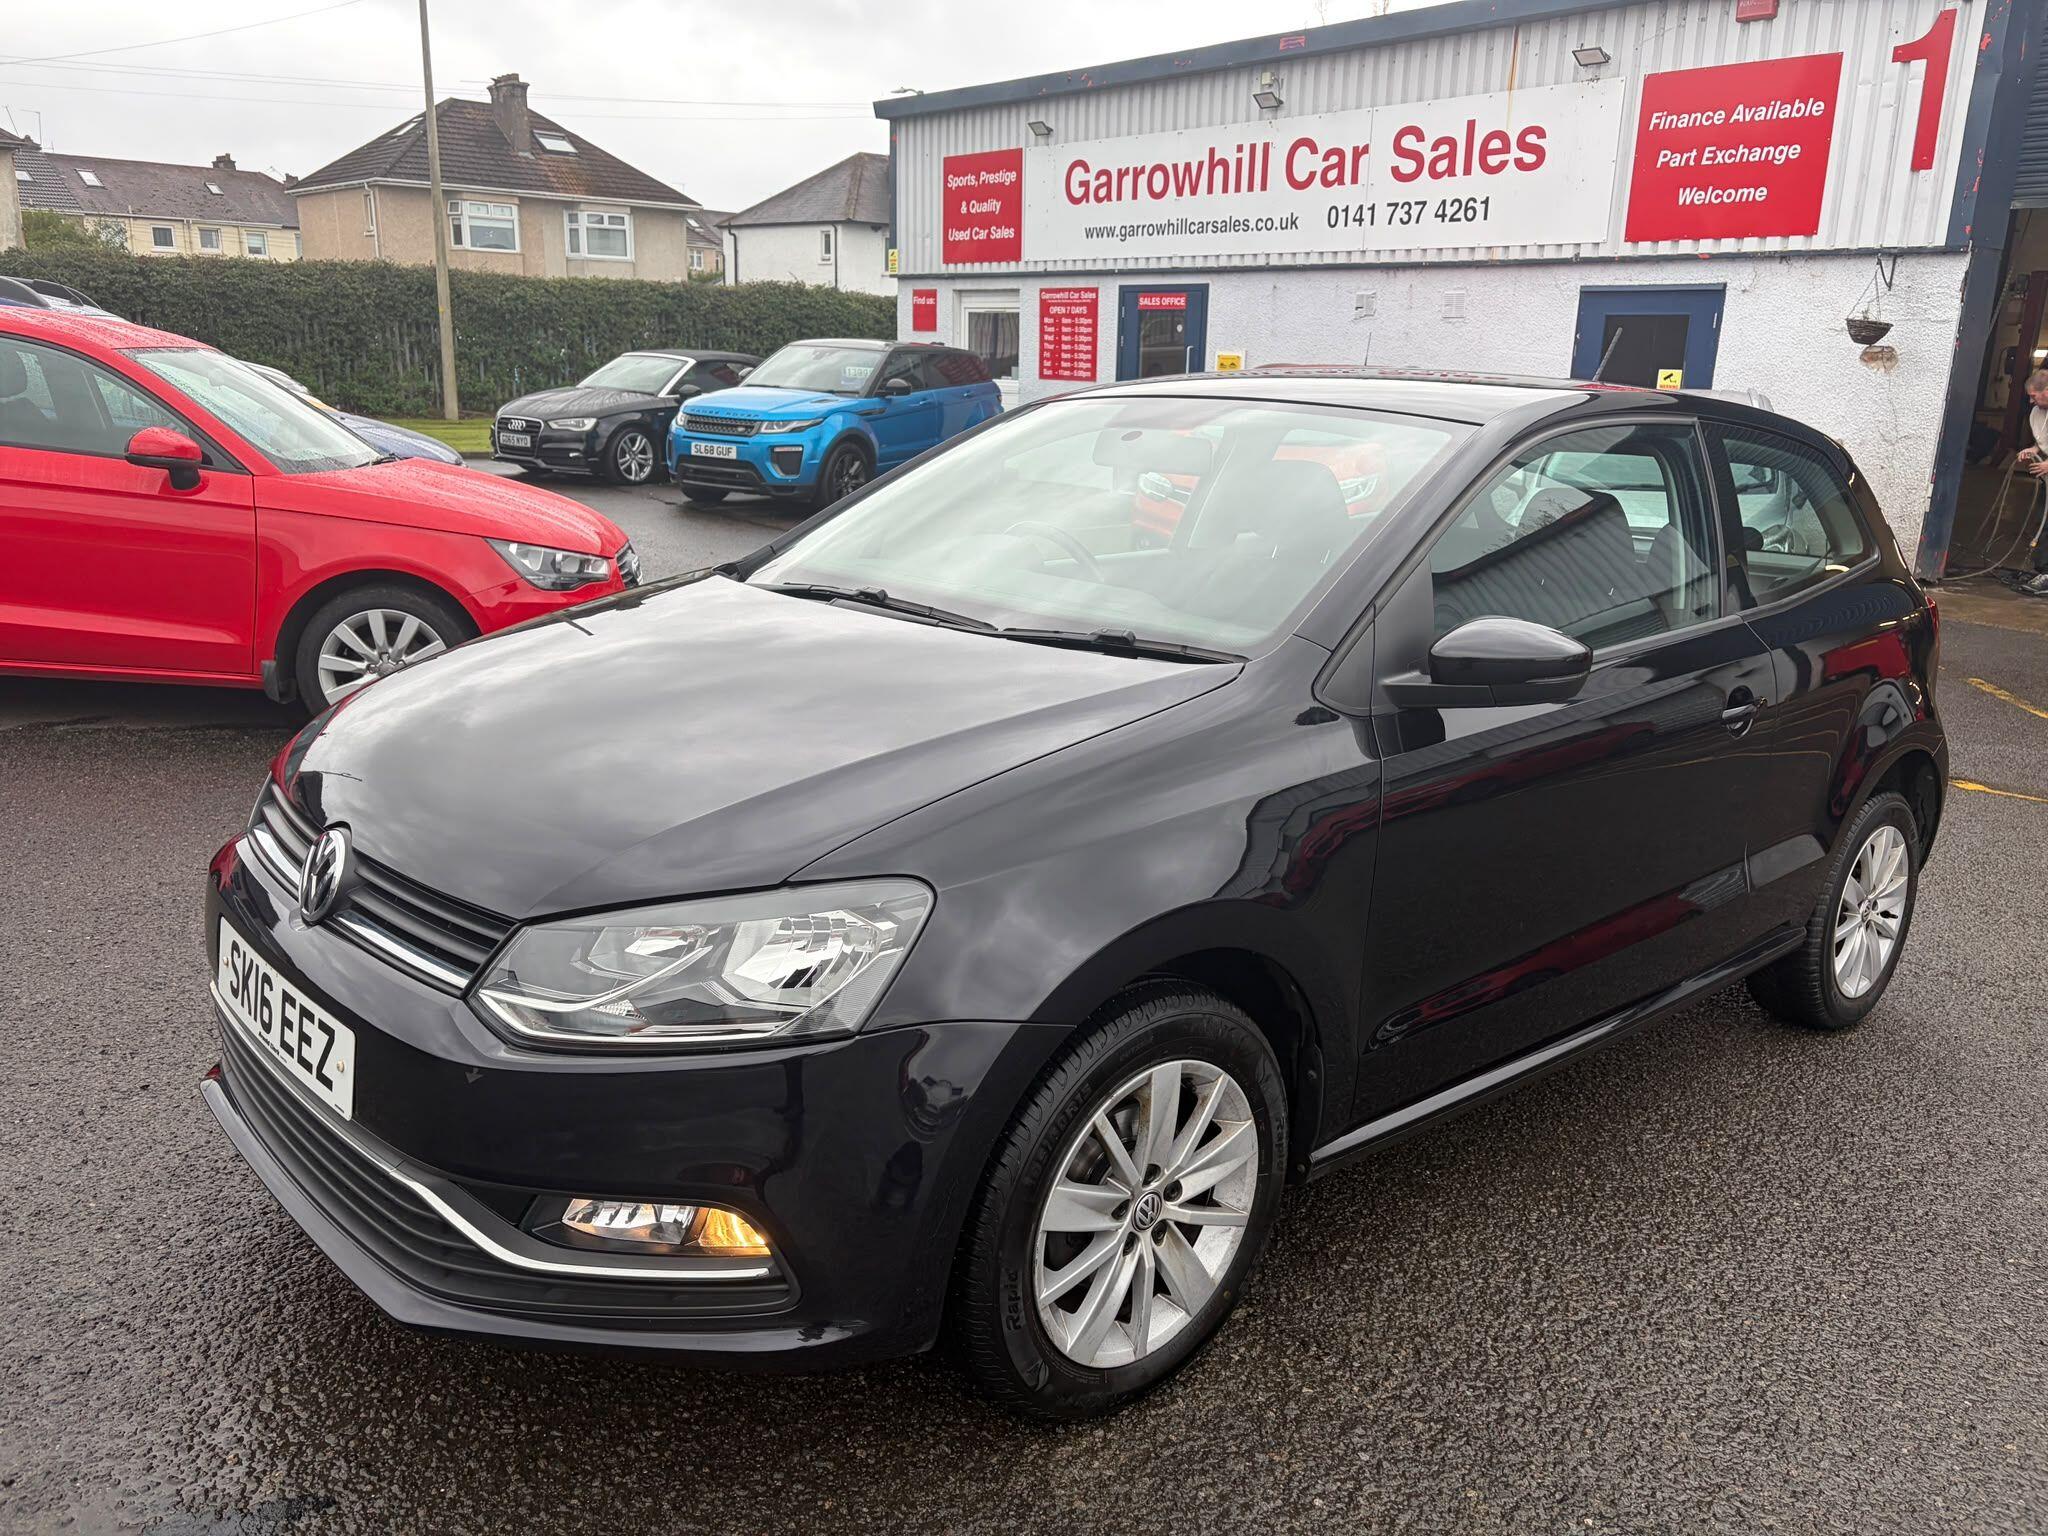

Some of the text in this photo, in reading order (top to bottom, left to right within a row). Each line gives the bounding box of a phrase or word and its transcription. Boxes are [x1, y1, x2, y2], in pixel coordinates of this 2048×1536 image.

[1892, 9, 1957, 172] 1
[1649, 98, 1825, 131] Finance Available
[1065, 119, 1547, 205] Garrowhill Car Sales
[1656, 143, 1801, 168] Part Exchange
[947, 169, 1017, 190] Sports, Prestige
[960, 198, 1001, 214] & Quality
[1678, 186, 1768, 206] Welcome
[1327, 196, 1490, 228] 0141 737 4261
[948, 225, 1014, 241] Used Car Sales
[1085, 212, 1299, 242] www.garrowhillcarsales.co.uk
[913, 296, 926, 304] Find
[1070, 291, 1079, 299] Car
[1080, 290, 1096, 299] Sales
[1139, 296, 1186, 306] SALES OFFICE
[1049, 306, 1066, 314] OPEN
[1071, 306, 1088, 314] DAYS
[694, 444, 733, 456] SL68 GUF
[229, 940, 336, 1092] SK16 EEZ
